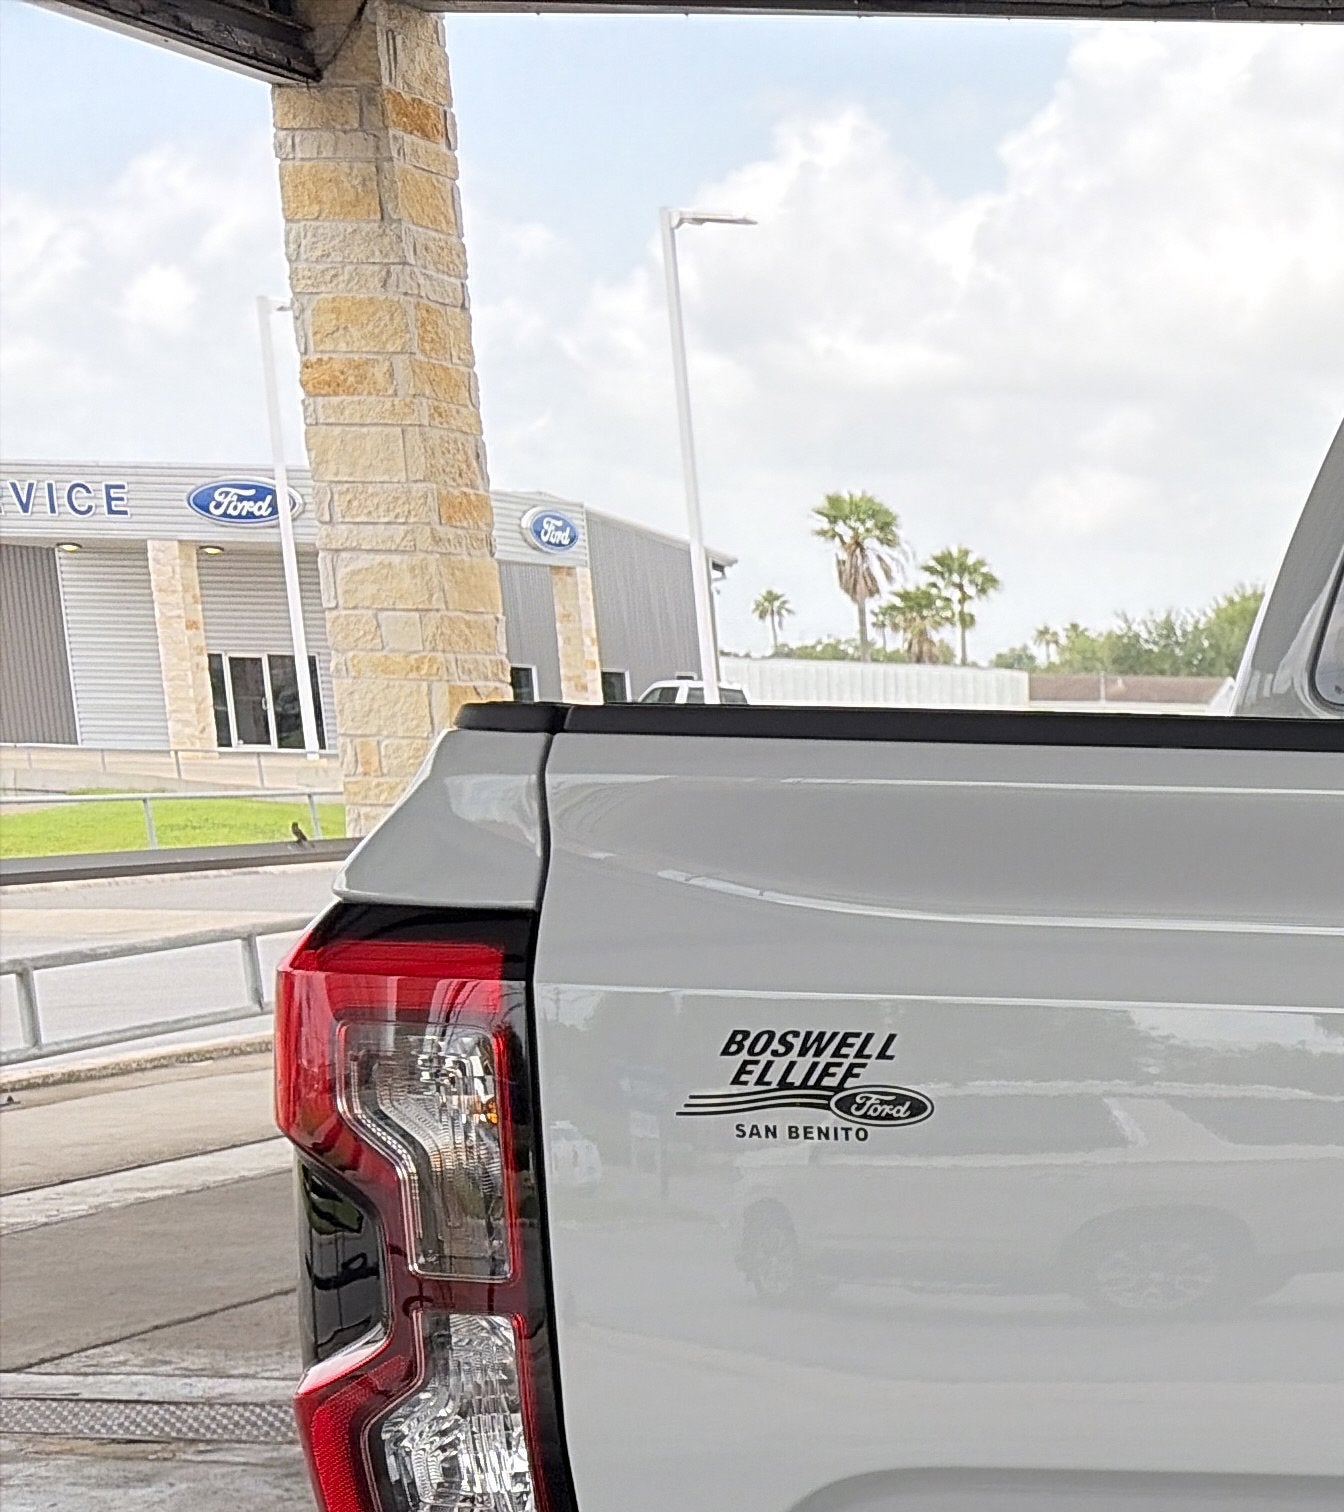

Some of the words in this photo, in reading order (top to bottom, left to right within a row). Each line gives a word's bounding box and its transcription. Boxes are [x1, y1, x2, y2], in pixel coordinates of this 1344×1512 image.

[0, 480, 131, 518] VICE
[208, 486, 272, 517] Ford
[541, 517, 571, 545] Ford
[719, 1029, 898, 1060] BOSWELL
[729, 1059, 868, 1089] ELLIFF
[850, 1093, 911, 1118] Ford
[734, 1123, 778, 1140] SAN
[787, 1125, 869, 1142] BENITO
